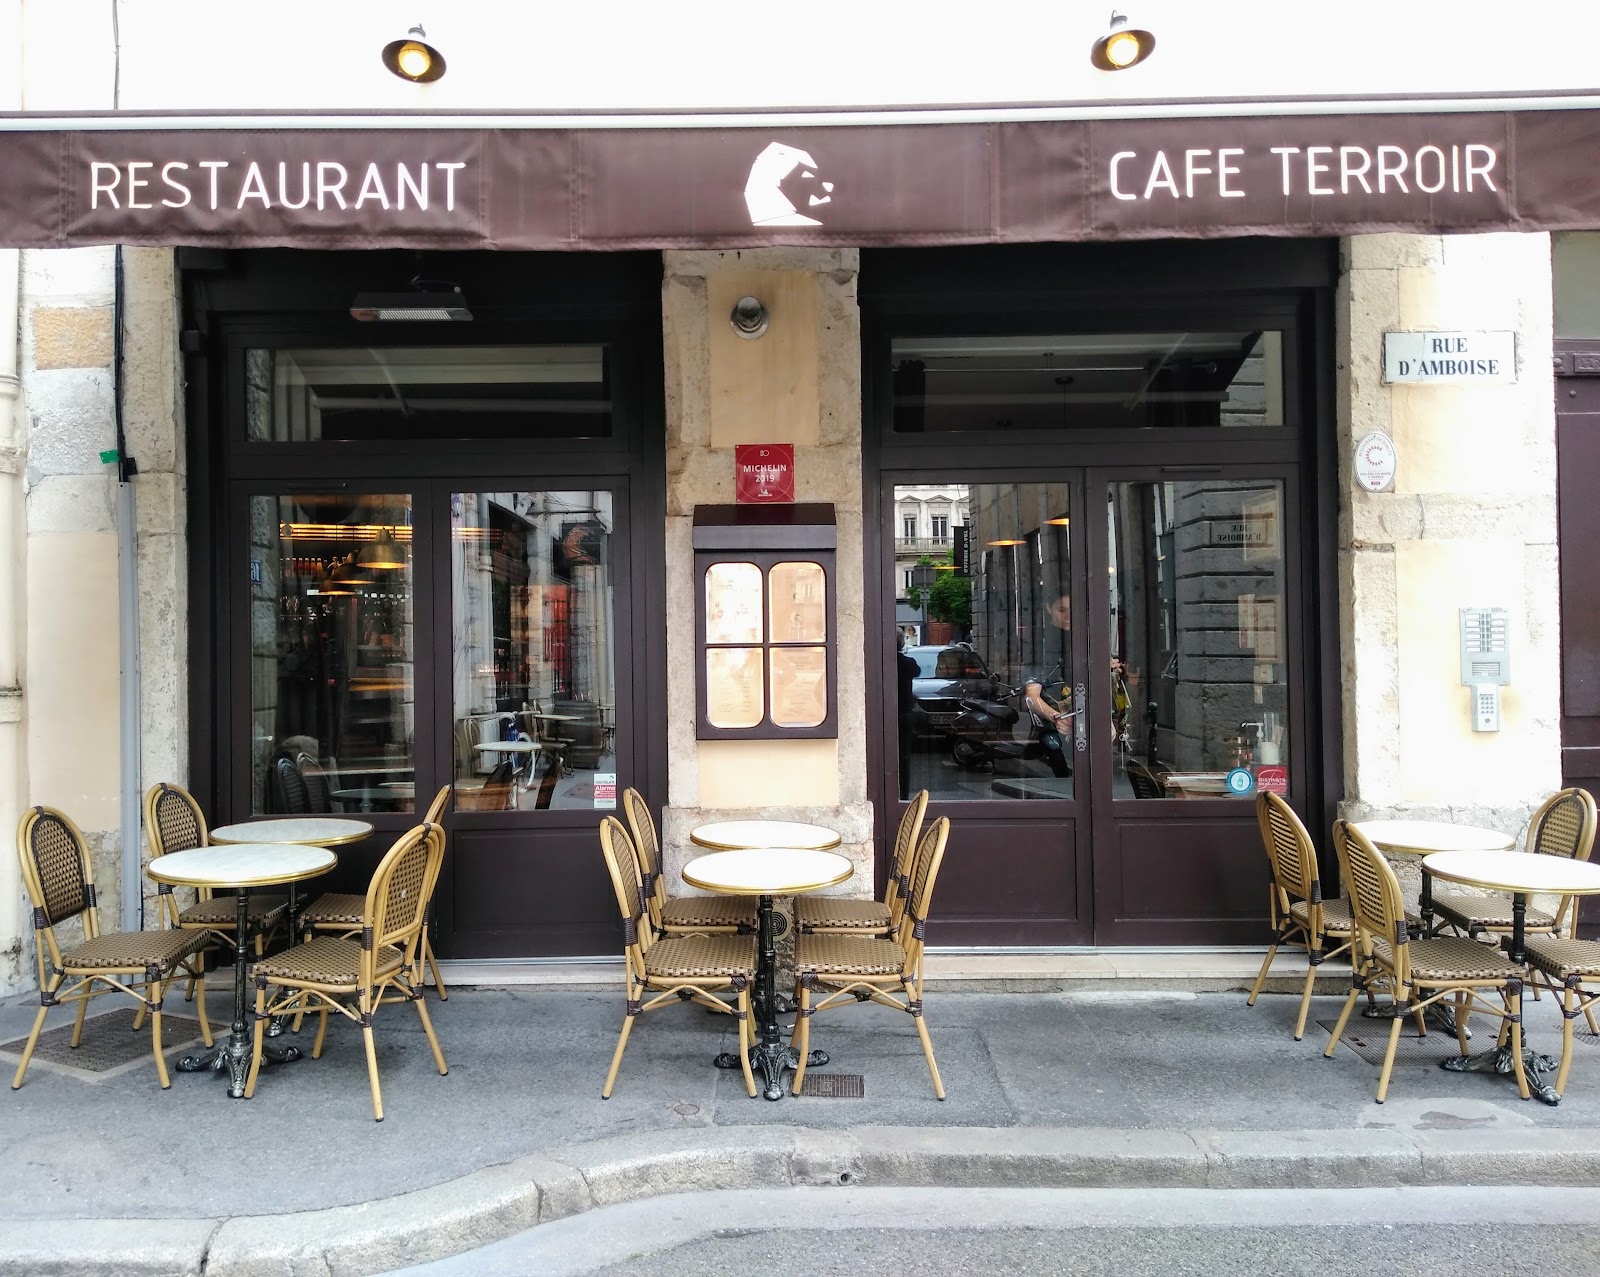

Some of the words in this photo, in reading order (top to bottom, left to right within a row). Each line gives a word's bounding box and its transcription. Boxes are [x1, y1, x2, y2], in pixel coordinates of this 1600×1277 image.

[1109, 147, 1246, 200] CAFE
[1270, 143, 1498, 196] TERROIR
[90, 160, 468, 212] RESTAURANT
[1431, 337, 1468, 354] RUE
[1398, 359, 1500, 376] D'AMBOISE
[743, 464, 787, 473] MICHELIN
[755, 474, 775, 483] 2019
